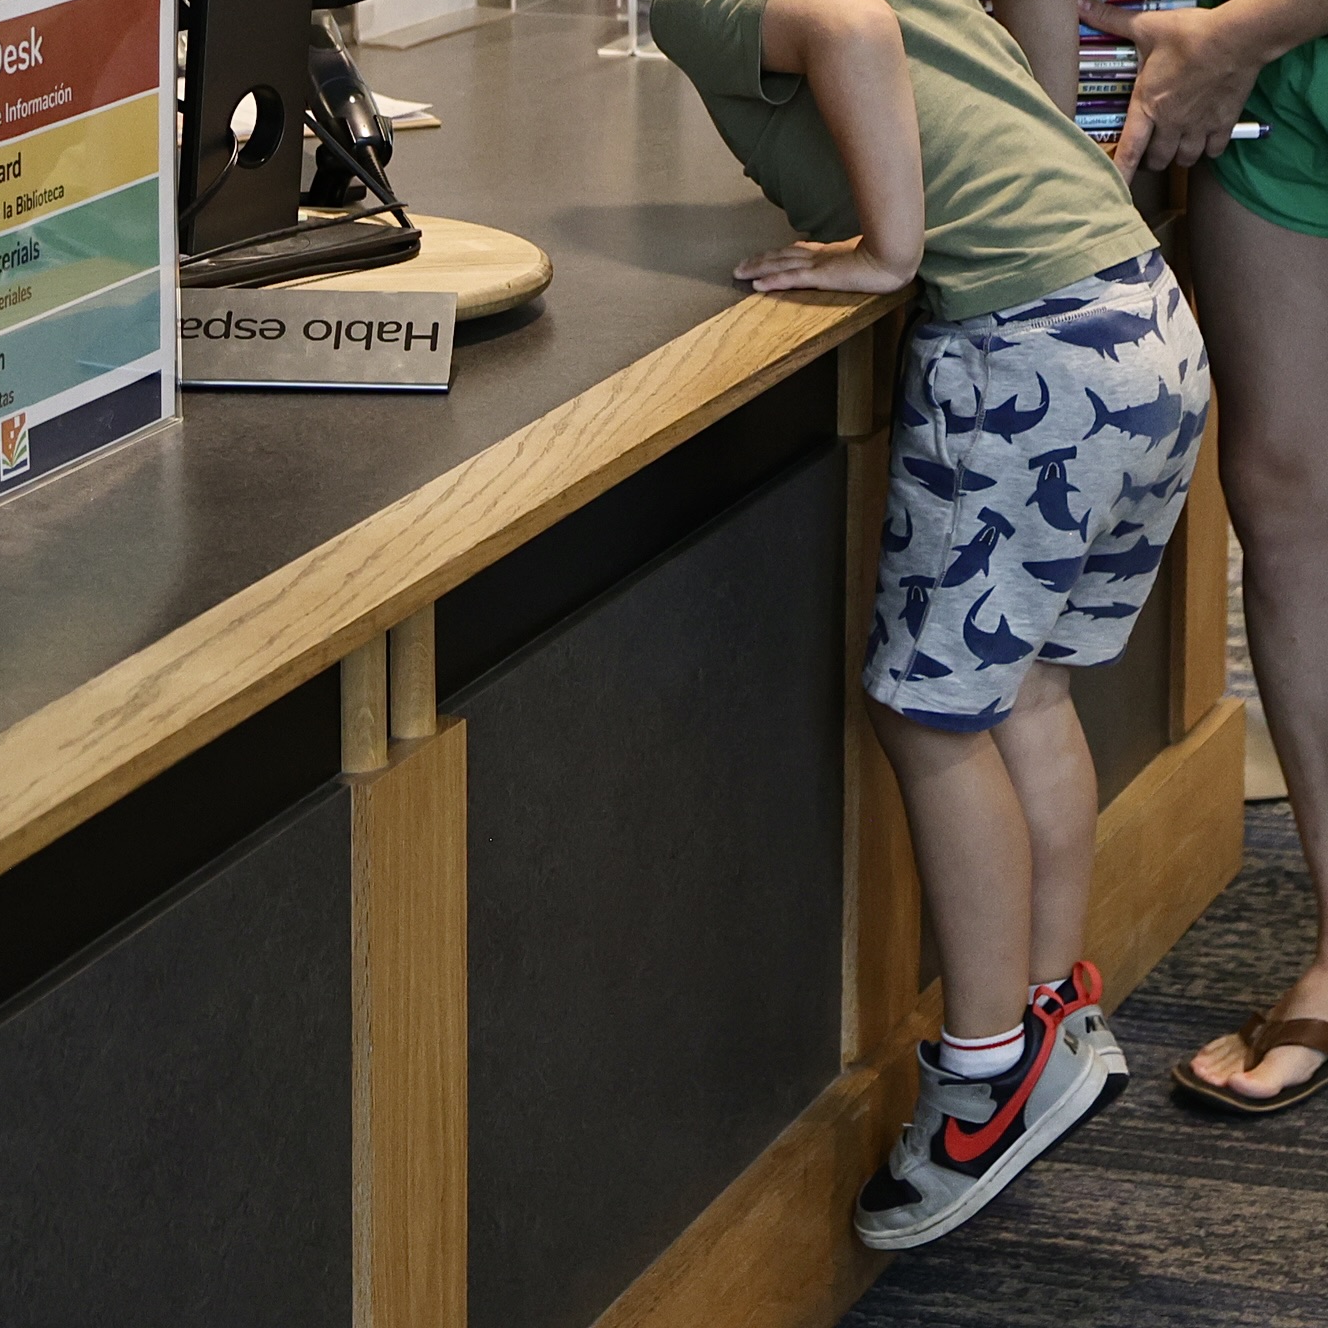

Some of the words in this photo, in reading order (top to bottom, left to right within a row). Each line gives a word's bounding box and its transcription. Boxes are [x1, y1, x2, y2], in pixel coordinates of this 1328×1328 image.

[5, 83, 73, 123] Información
[2, 201, 13, 220] la
[16, 184, 65, 216] Biblioteca
[181, 311, 286, 340] espa
[303, 319, 439, 351] Hablo
